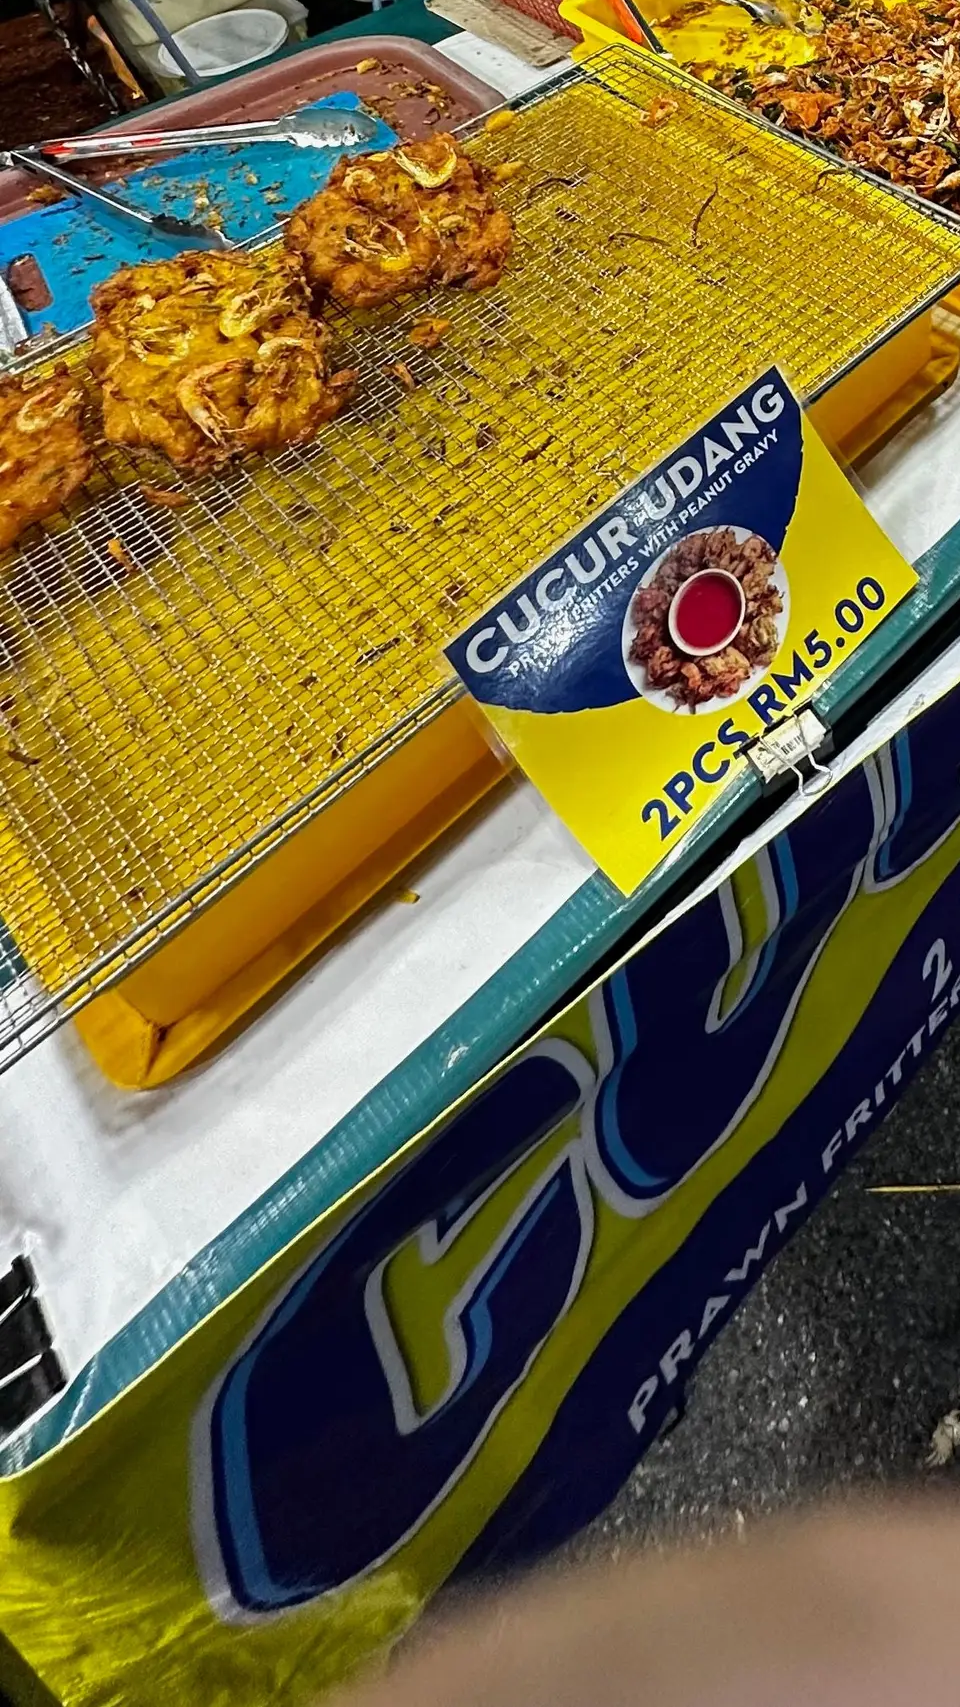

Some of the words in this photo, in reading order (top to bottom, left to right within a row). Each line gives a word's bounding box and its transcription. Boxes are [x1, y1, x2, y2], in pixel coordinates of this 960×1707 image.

[465, 514, 642, 675] CUCUR
[641, 382, 786, 521] UDANG
[638, 514, 681, 565] WITH
[677, 474, 735, 527] PEANUT
[732, 427, 780, 478] GRAVY
[641, 718, 749, 843] 2PCS
[747, 575, 887, 727] RM5.00
[922, 941, 955, 1002] 2
[628, 1184, 810, 1436] PRAWN
